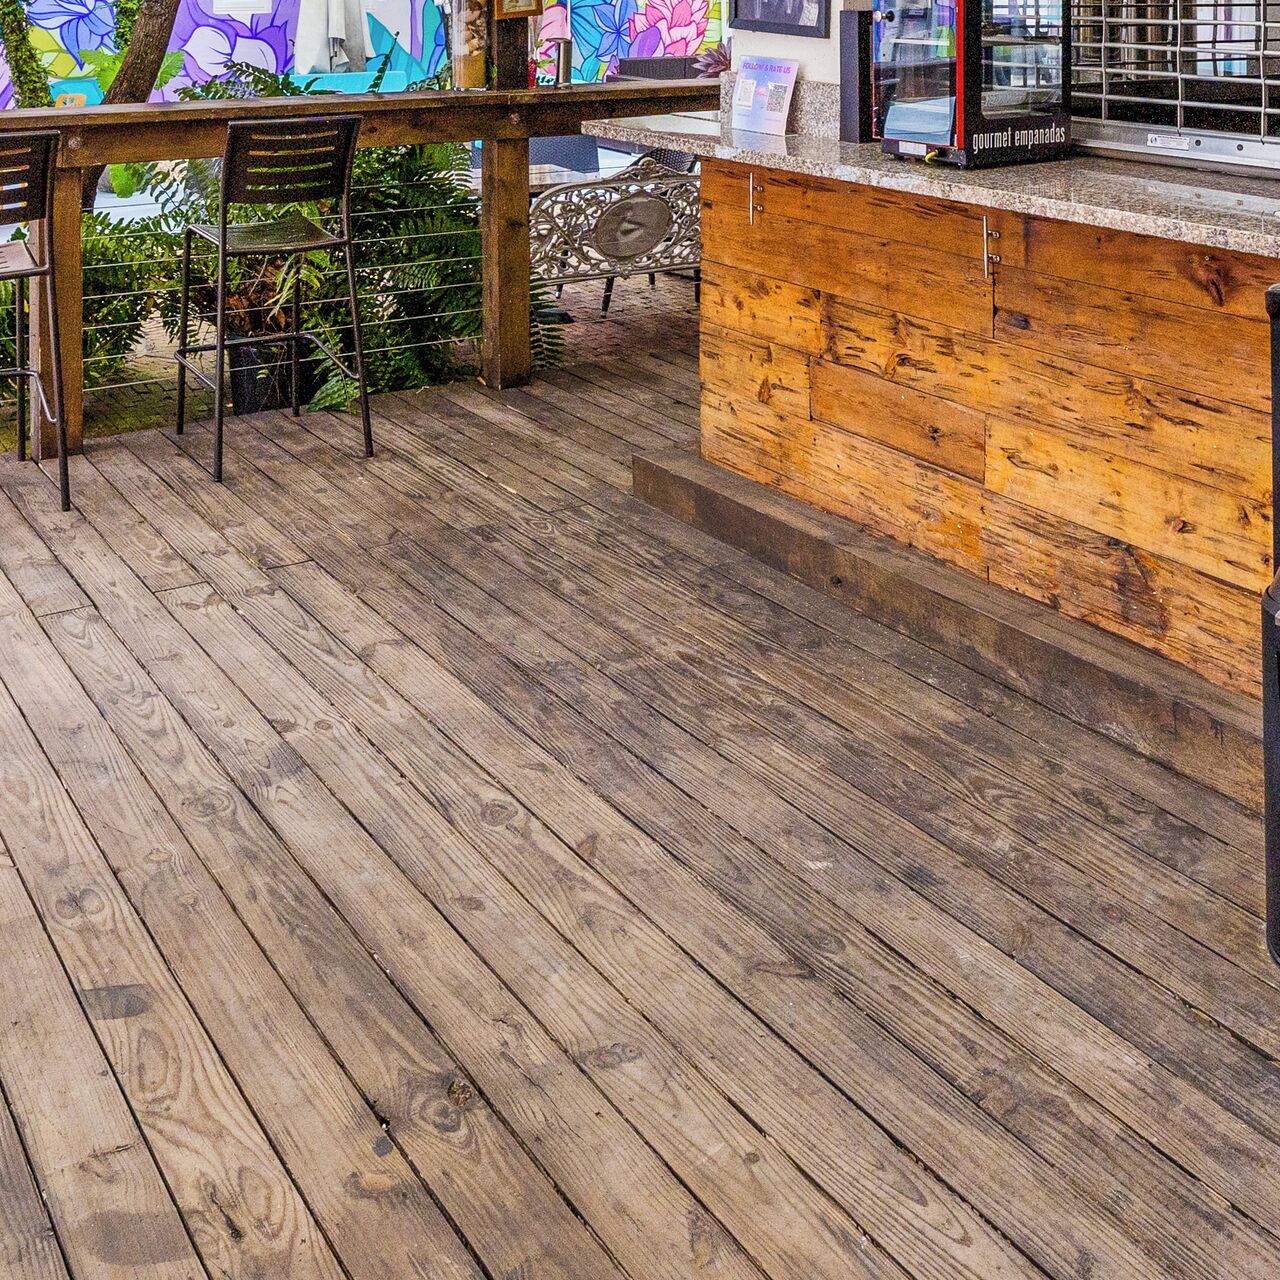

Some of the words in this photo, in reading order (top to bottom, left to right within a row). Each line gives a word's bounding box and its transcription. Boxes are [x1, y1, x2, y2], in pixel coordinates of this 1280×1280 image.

[742, 62, 764, 71] FOLLOW
[769, 65, 783, 73] RATE
[783, 66, 792, 74] US
[972, 126, 1012, 154] gourmet
[1014, 122, 1066, 149] empanadas
